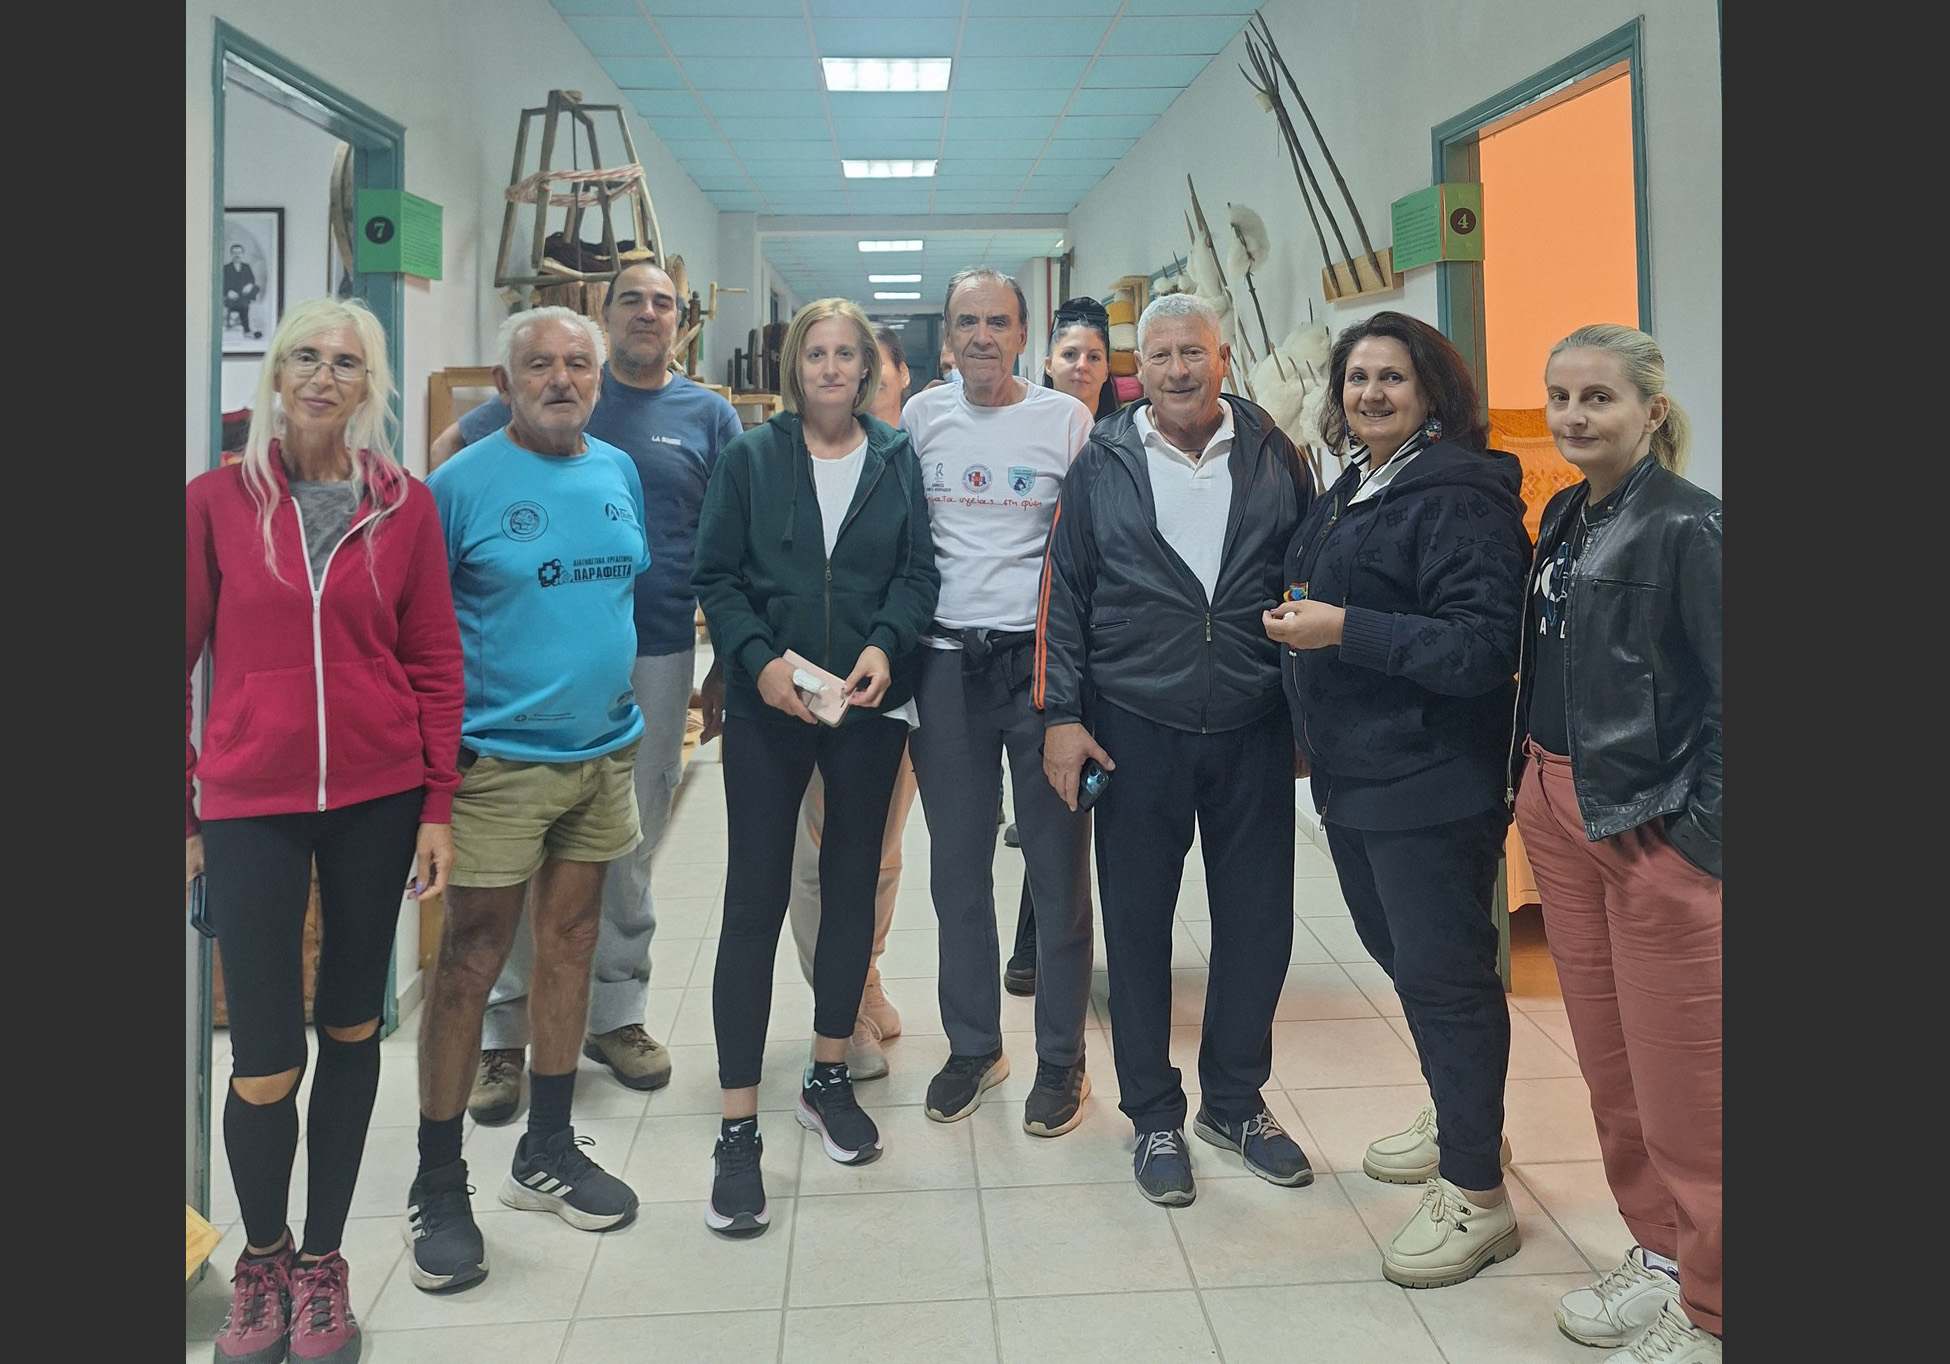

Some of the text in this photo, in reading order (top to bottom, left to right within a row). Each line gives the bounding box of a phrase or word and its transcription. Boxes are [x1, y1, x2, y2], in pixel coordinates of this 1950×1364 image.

[1457, 213, 1469, 229] 4
[374, 221, 386, 239] 7
[573, 564, 632, 581] ΠΑΡΑΦΕΣΤΑ
